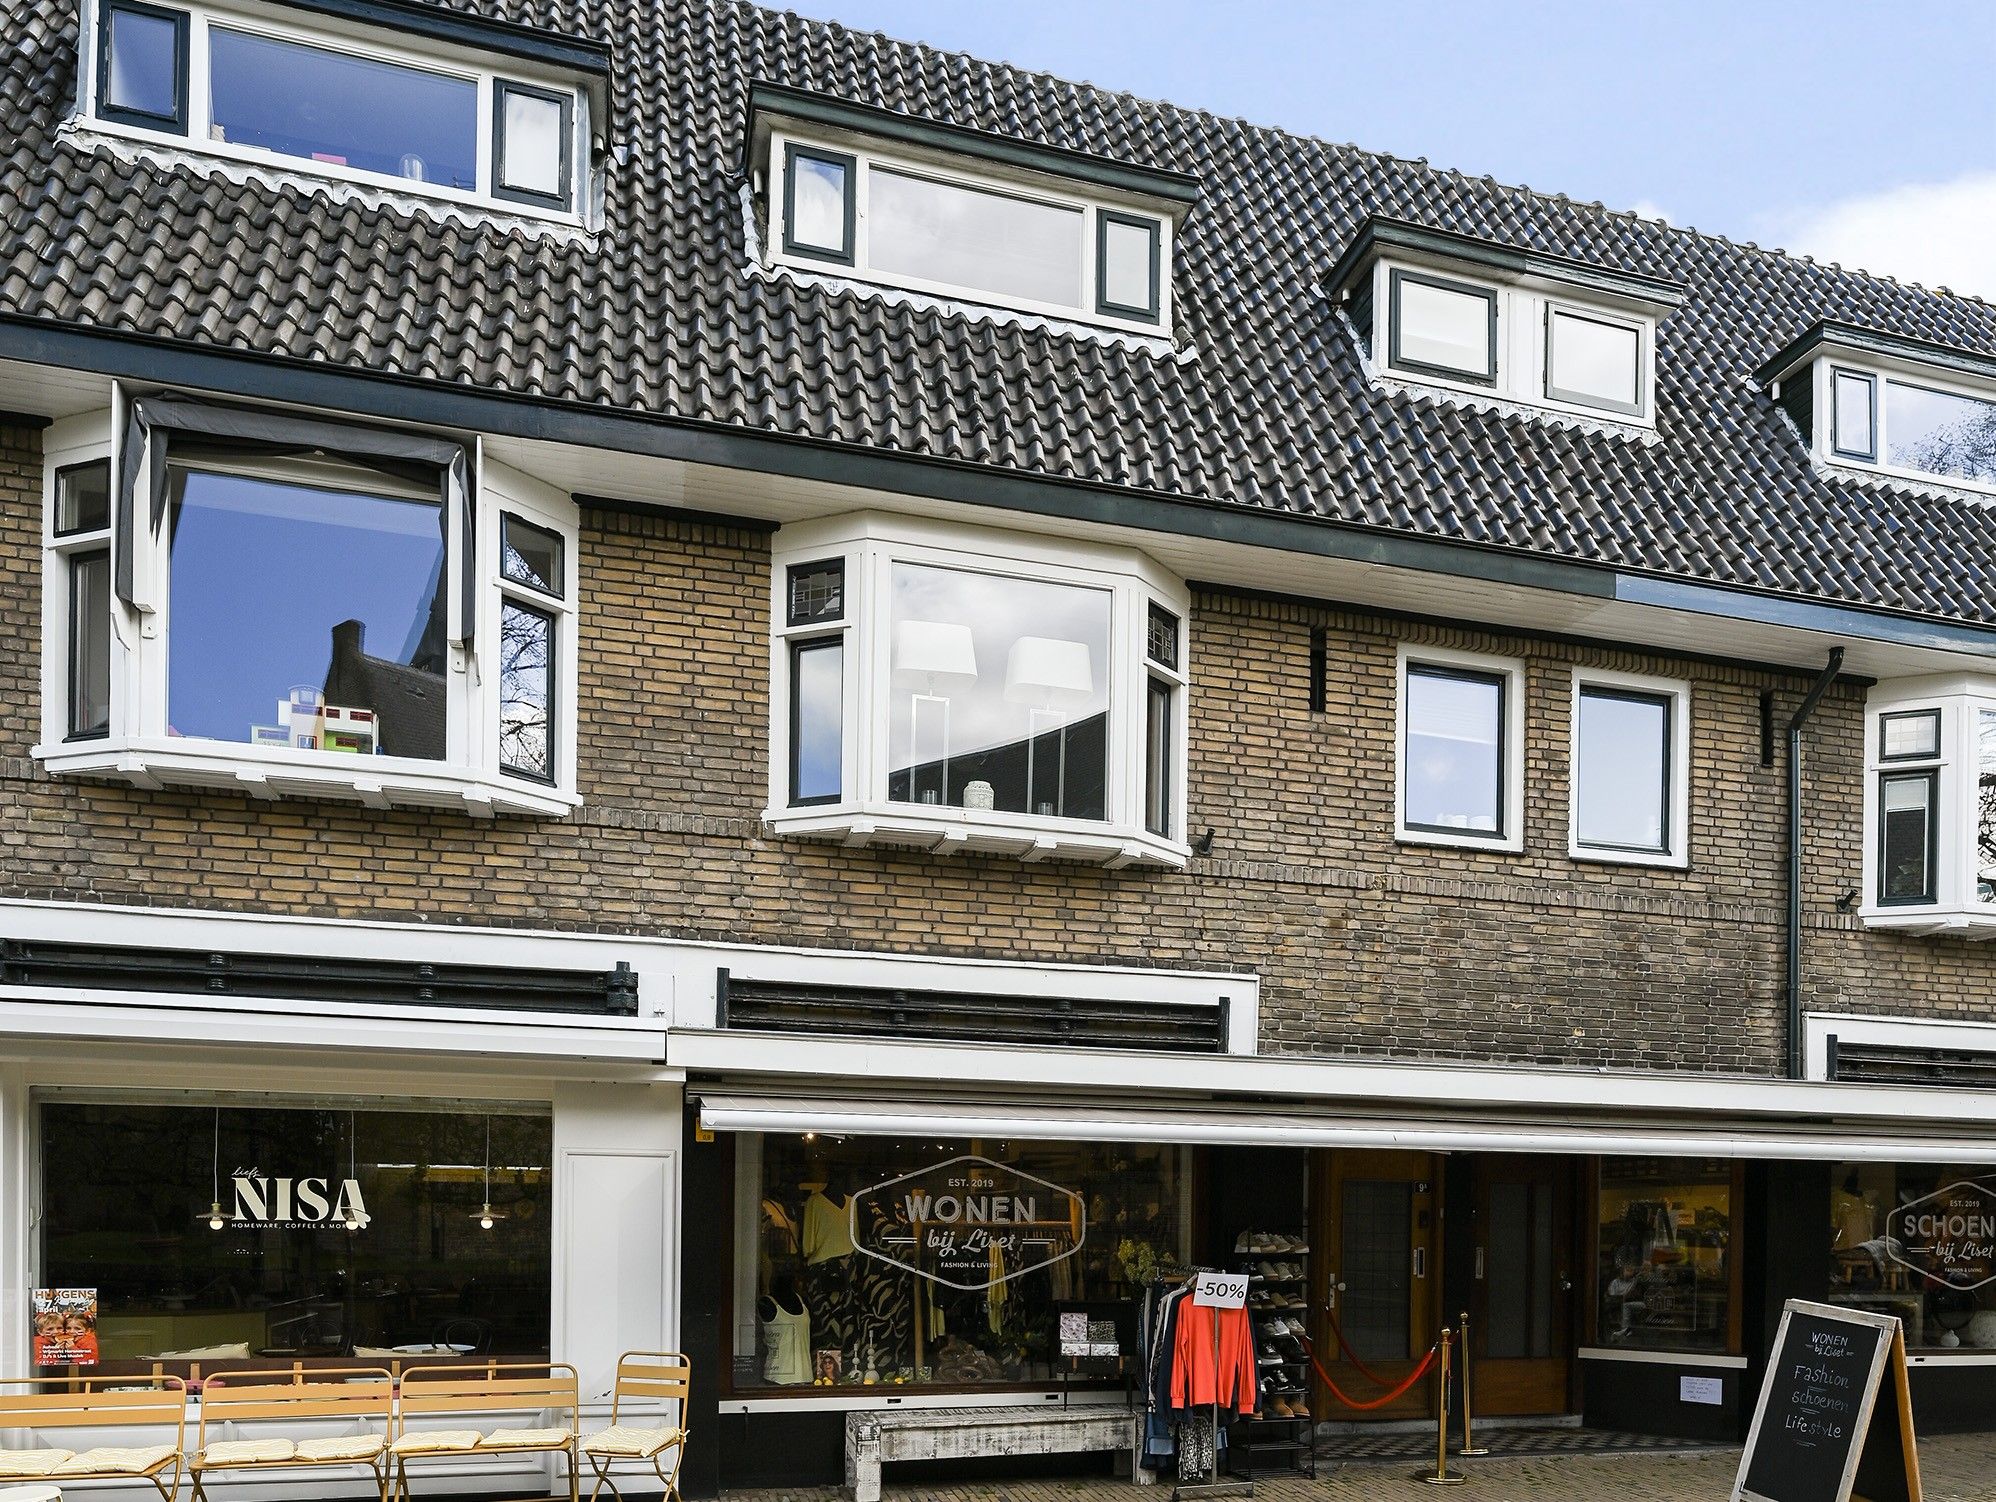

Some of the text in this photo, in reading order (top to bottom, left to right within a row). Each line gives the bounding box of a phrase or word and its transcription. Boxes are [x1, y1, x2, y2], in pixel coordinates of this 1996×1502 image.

[231, 1166, 261, 1179] liefs
[948, 1178, 994, 1187] EST. 2019
[231, 1177, 368, 1222] NISA
[904, 1195, 1036, 1224] WONEN
[1965, 1200, 1980, 1208] 2019
[1903, 1214, 1996, 1238] SCHOEN
[927, 1228, 1016, 1258] bij Liset
[1936, 1240, 1995, 1263] bij Liset
[1196, 1281, 1245, 1299] -50%
[1811, 1331, 1849, 1347] WONEN
[1823, 1345, 1844, 1357] Liset
[1793, 1364, 1849, 1389] Fashion
